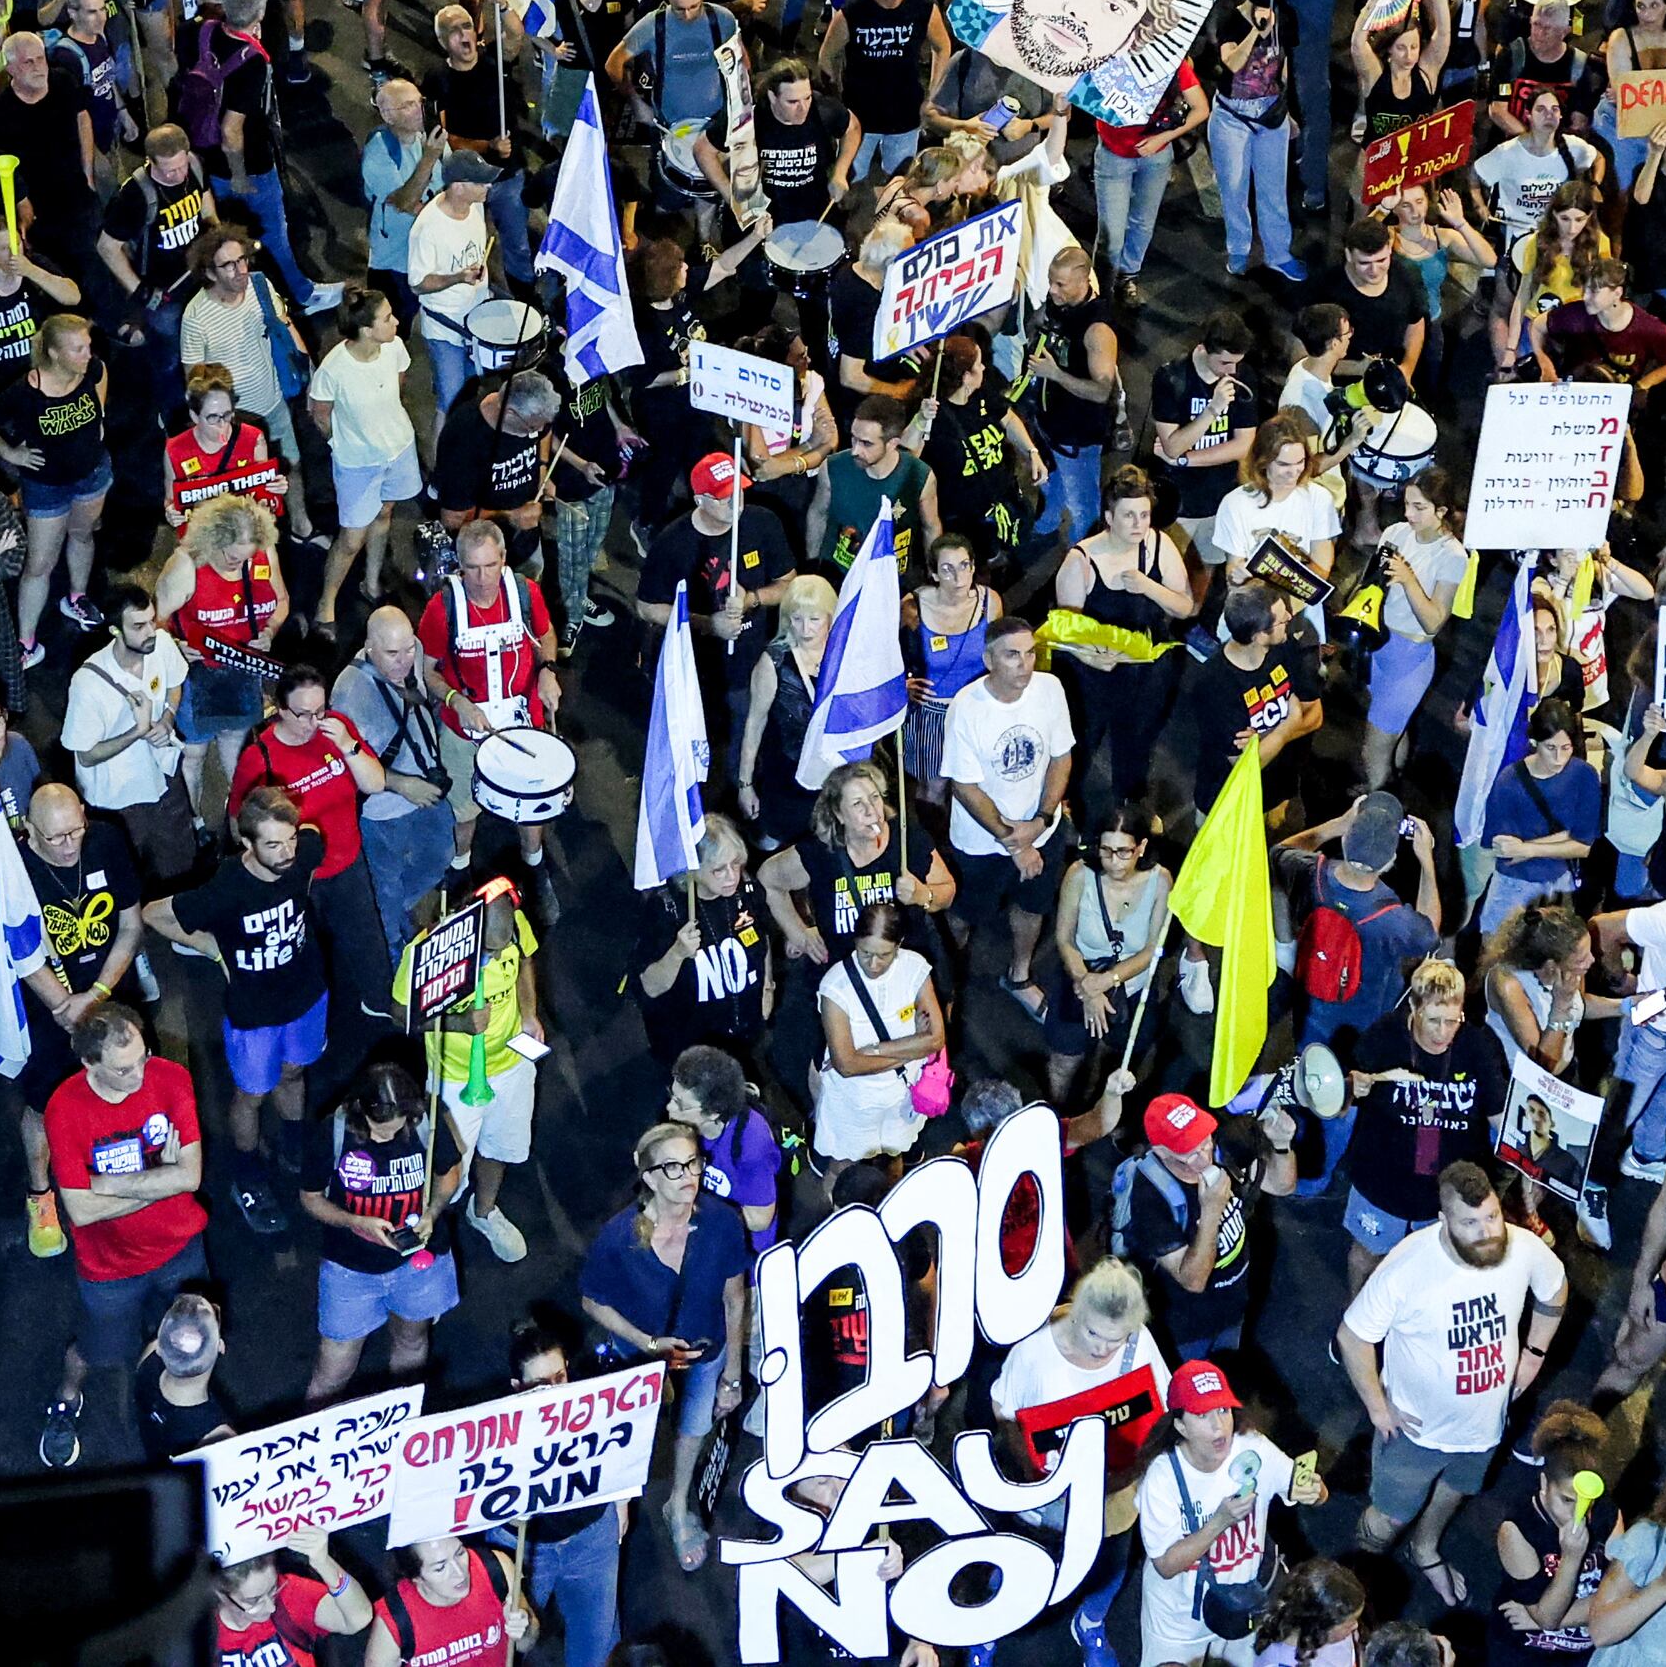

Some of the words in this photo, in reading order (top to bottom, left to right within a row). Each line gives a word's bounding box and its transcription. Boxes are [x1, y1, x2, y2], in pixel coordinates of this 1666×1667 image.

[1105, 92, 1138, 118] אלון
[159, 190, 201, 227] נחזיר
[160, 215, 200, 252] נקום
[971, 213, 1017, 252] את
[902, 237, 960, 286] כולם
[894, 245, 1003, 321] הביתה
[906, 282, 994, 343] עכשיו
[739, 366, 781, 392] סדום
[725, 390, 791, 423] ממשלה
[1509, 395, 1531, 408] על
[1540, 392, 1613, 409] החטופים
[1551, 416, 1619, 436] ממשלת
[1572, 444, 1613, 464] זדון
[181, 479, 230, 505] BRING
[231, 469, 276, 492] THEM
[1557, 492, 1607, 510] חורבן
[44, 905, 74, 924] BRING
[243, 898, 295, 935] חיים
[85, 925, 109, 944] NOW
[420, 915, 475, 963] ממשלת
[236, 944, 294, 972] Life
[415, 934, 476, 984] ההפקרה
[694, 937, 757, 1002] NO.
[421, 959, 469, 1013] הביתה
[1451, 1291, 1498, 1327] אתה
[1447, 1315, 1507, 1350] הראש
[1457, 1341, 1503, 1372] אתה
[1454, 1365, 1506, 1397] אשם
[239, 1426, 319, 1462] אכזר
[402, 1410, 523, 1468] מתרחש
[531, 1421, 634, 1467] ברגע
[267, 1456, 316, 1490] את
[349, 1464, 391, 1490] כדי
[459, 1457, 513, 1493] זה
[723, 1416, 1097, 1607] SAY
[745, 1534, 1037, 1666] NO
